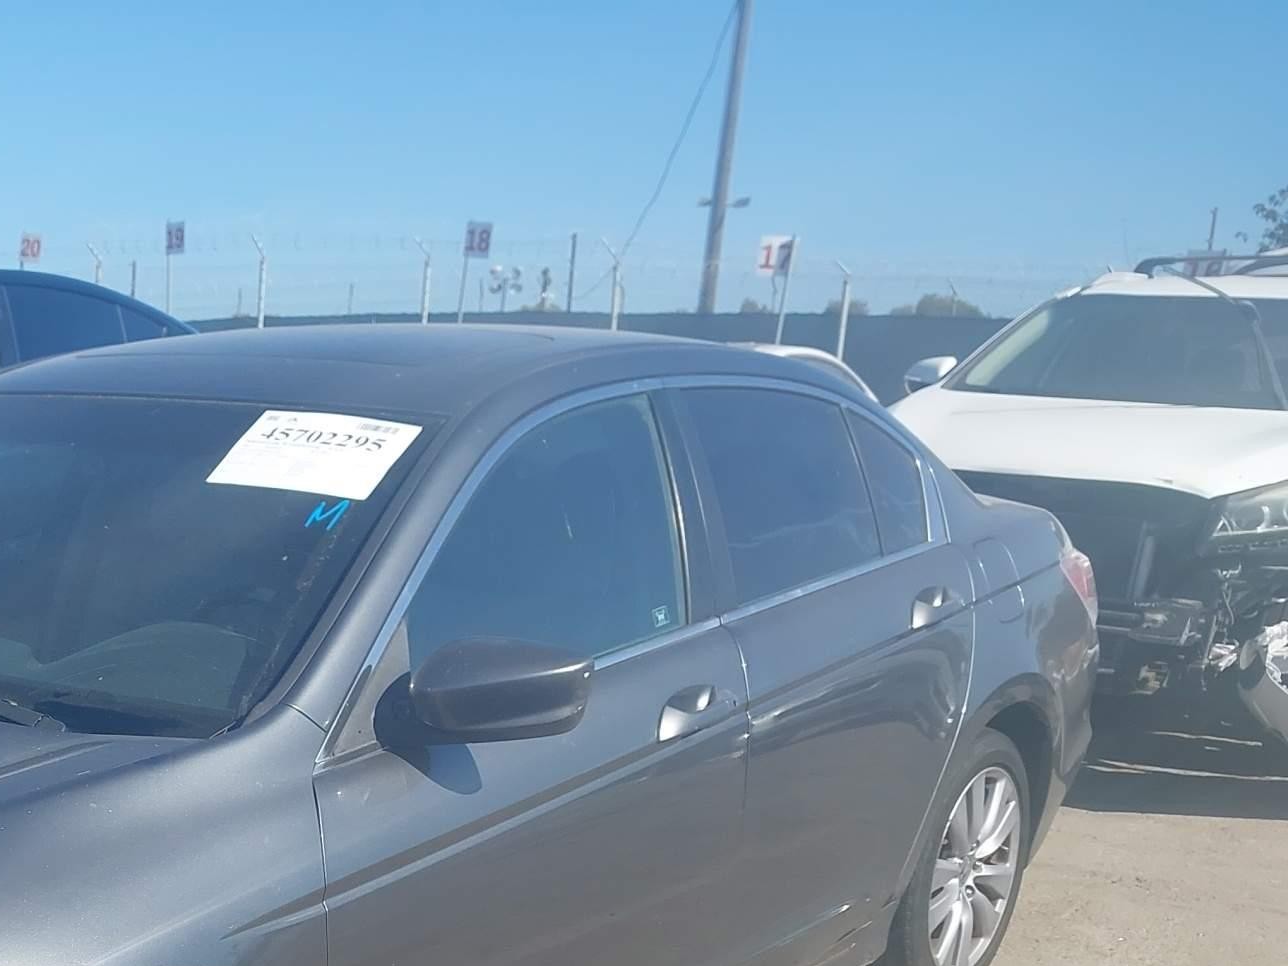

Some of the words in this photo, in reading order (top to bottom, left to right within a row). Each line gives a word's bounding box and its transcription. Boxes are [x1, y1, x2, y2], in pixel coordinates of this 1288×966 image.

[20, 237, 41, 258] 20
[464, 229, 491, 252] 18
[261, 427, 387, 452] 45702295
[304, 499, 351, 531] M
